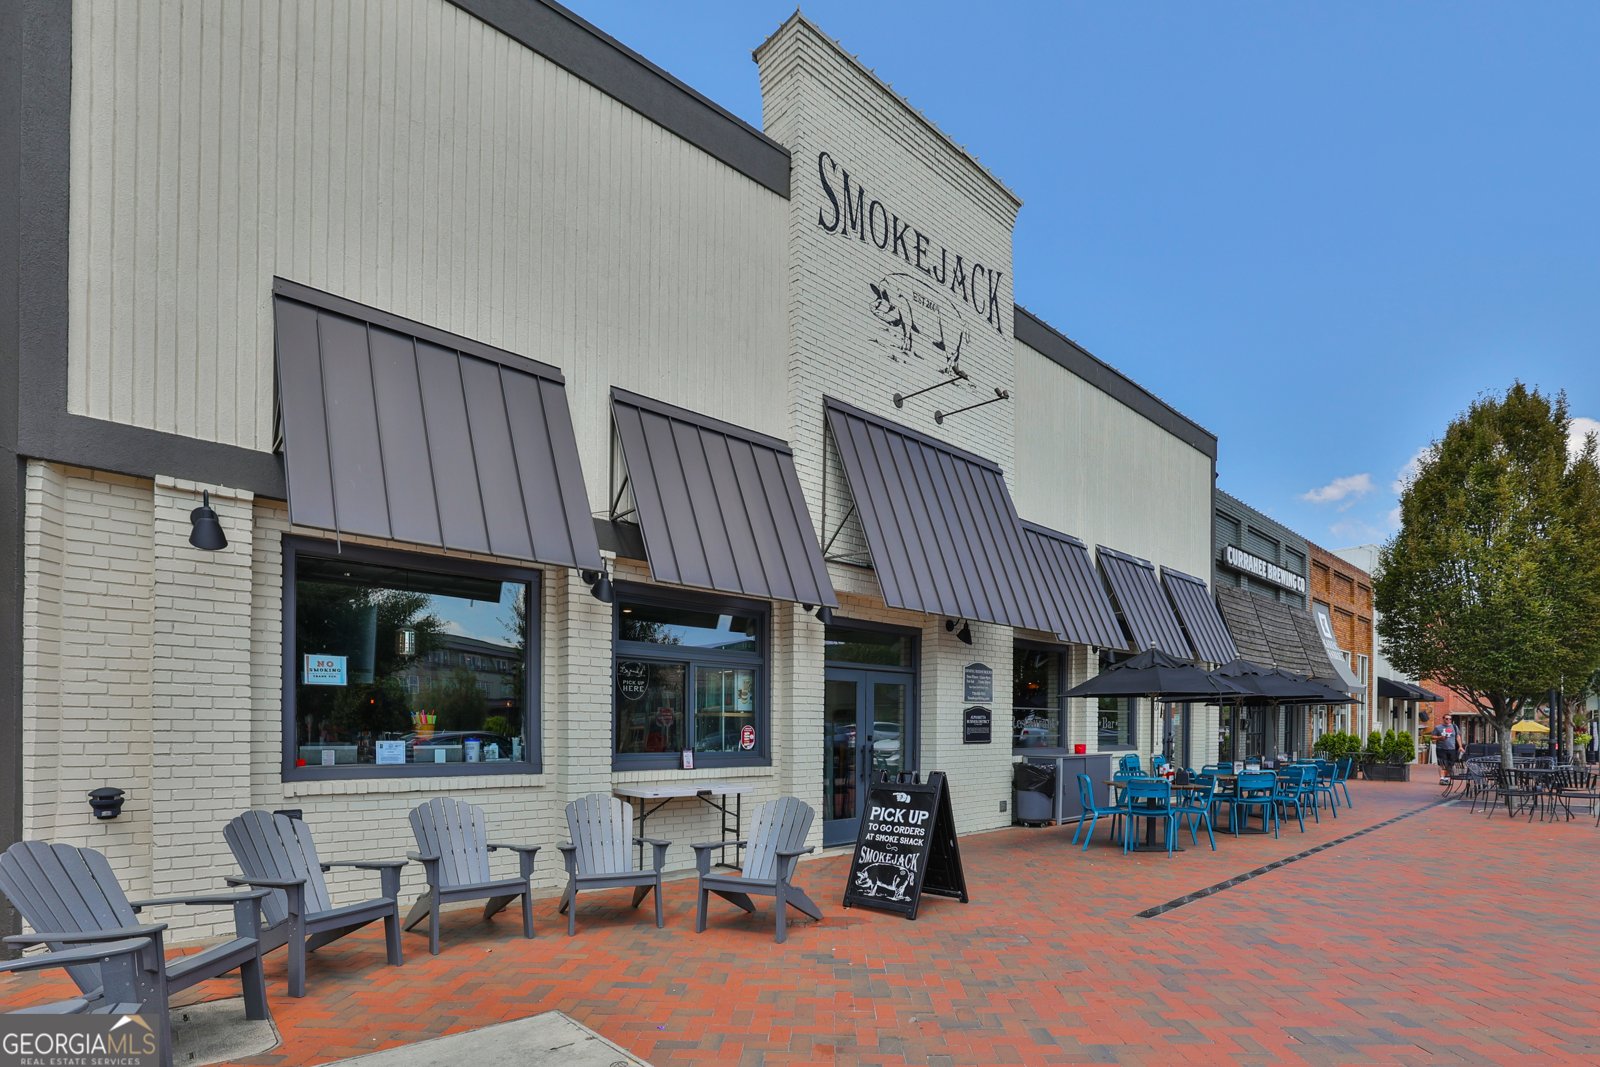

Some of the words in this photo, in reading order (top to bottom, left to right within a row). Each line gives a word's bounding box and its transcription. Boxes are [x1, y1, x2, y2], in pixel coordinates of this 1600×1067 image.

[818, 151, 1005, 336] SMOKEJACK
[1226, 546, 1267, 579] CURRAHEE
[1267, 563, 1297, 590] BREWING
[1297, 576, 1306, 593] CO
[622, 685, 645, 693] HERE
[1102, 716, 1115, 729] Bar
[870, 806, 907, 823] PICK
[909, 809, 930, 826] UP
[868, 822, 879, 831] TO
[880, 824, 892, 832] GO
[893, 826, 925, 836] ORDERS
[865, 832, 875, 841] AT
[875, 834, 900, 844] SMOKE
[900, 837, 924, 846] SHACK
[859, 846, 920, 872] SMOKEJACK
